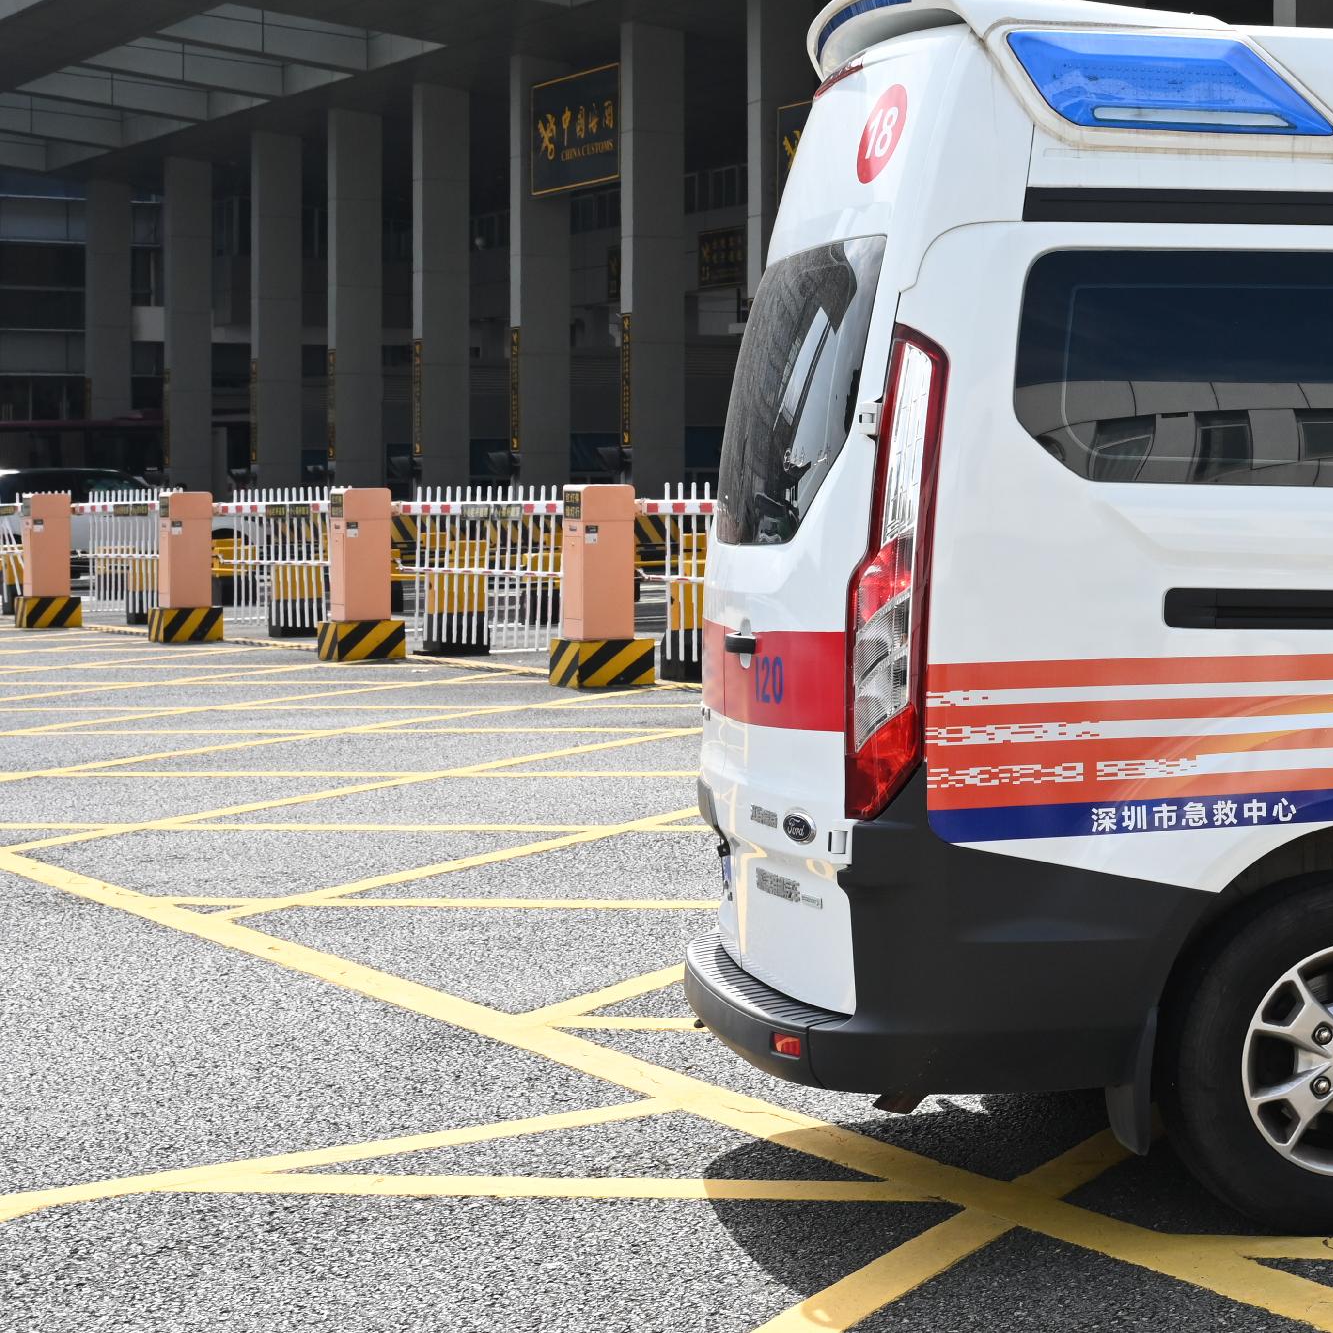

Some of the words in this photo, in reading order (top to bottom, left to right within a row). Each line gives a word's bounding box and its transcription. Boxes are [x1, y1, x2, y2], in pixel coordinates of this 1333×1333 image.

[866, 105, 899, 159] 18
[755, 655, 784, 705] 120
[786, 817, 805, 837] Ford
[1091, 797, 1297, 833] 深圳市急救中心
